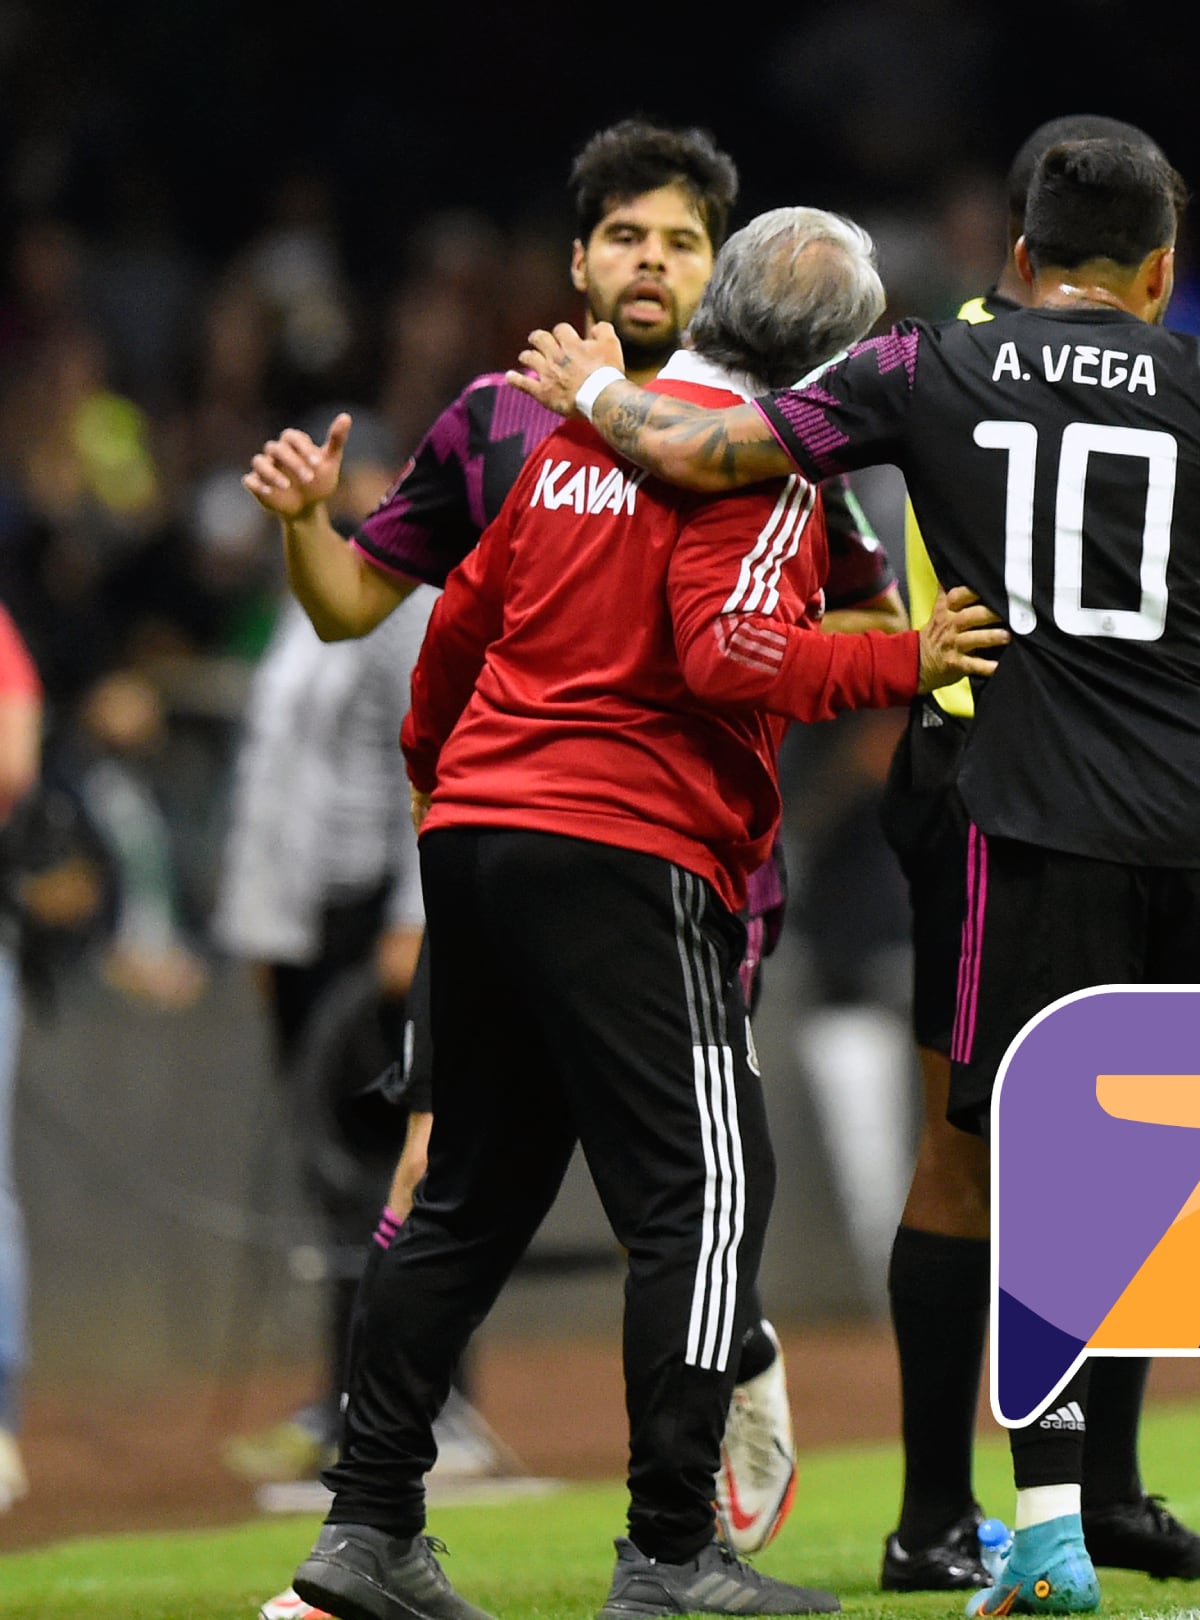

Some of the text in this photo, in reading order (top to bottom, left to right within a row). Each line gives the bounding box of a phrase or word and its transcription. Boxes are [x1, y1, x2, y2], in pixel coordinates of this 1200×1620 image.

[992, 342, 1156, 396] A. VEGA
[973, 420, 1178, 641] 10
